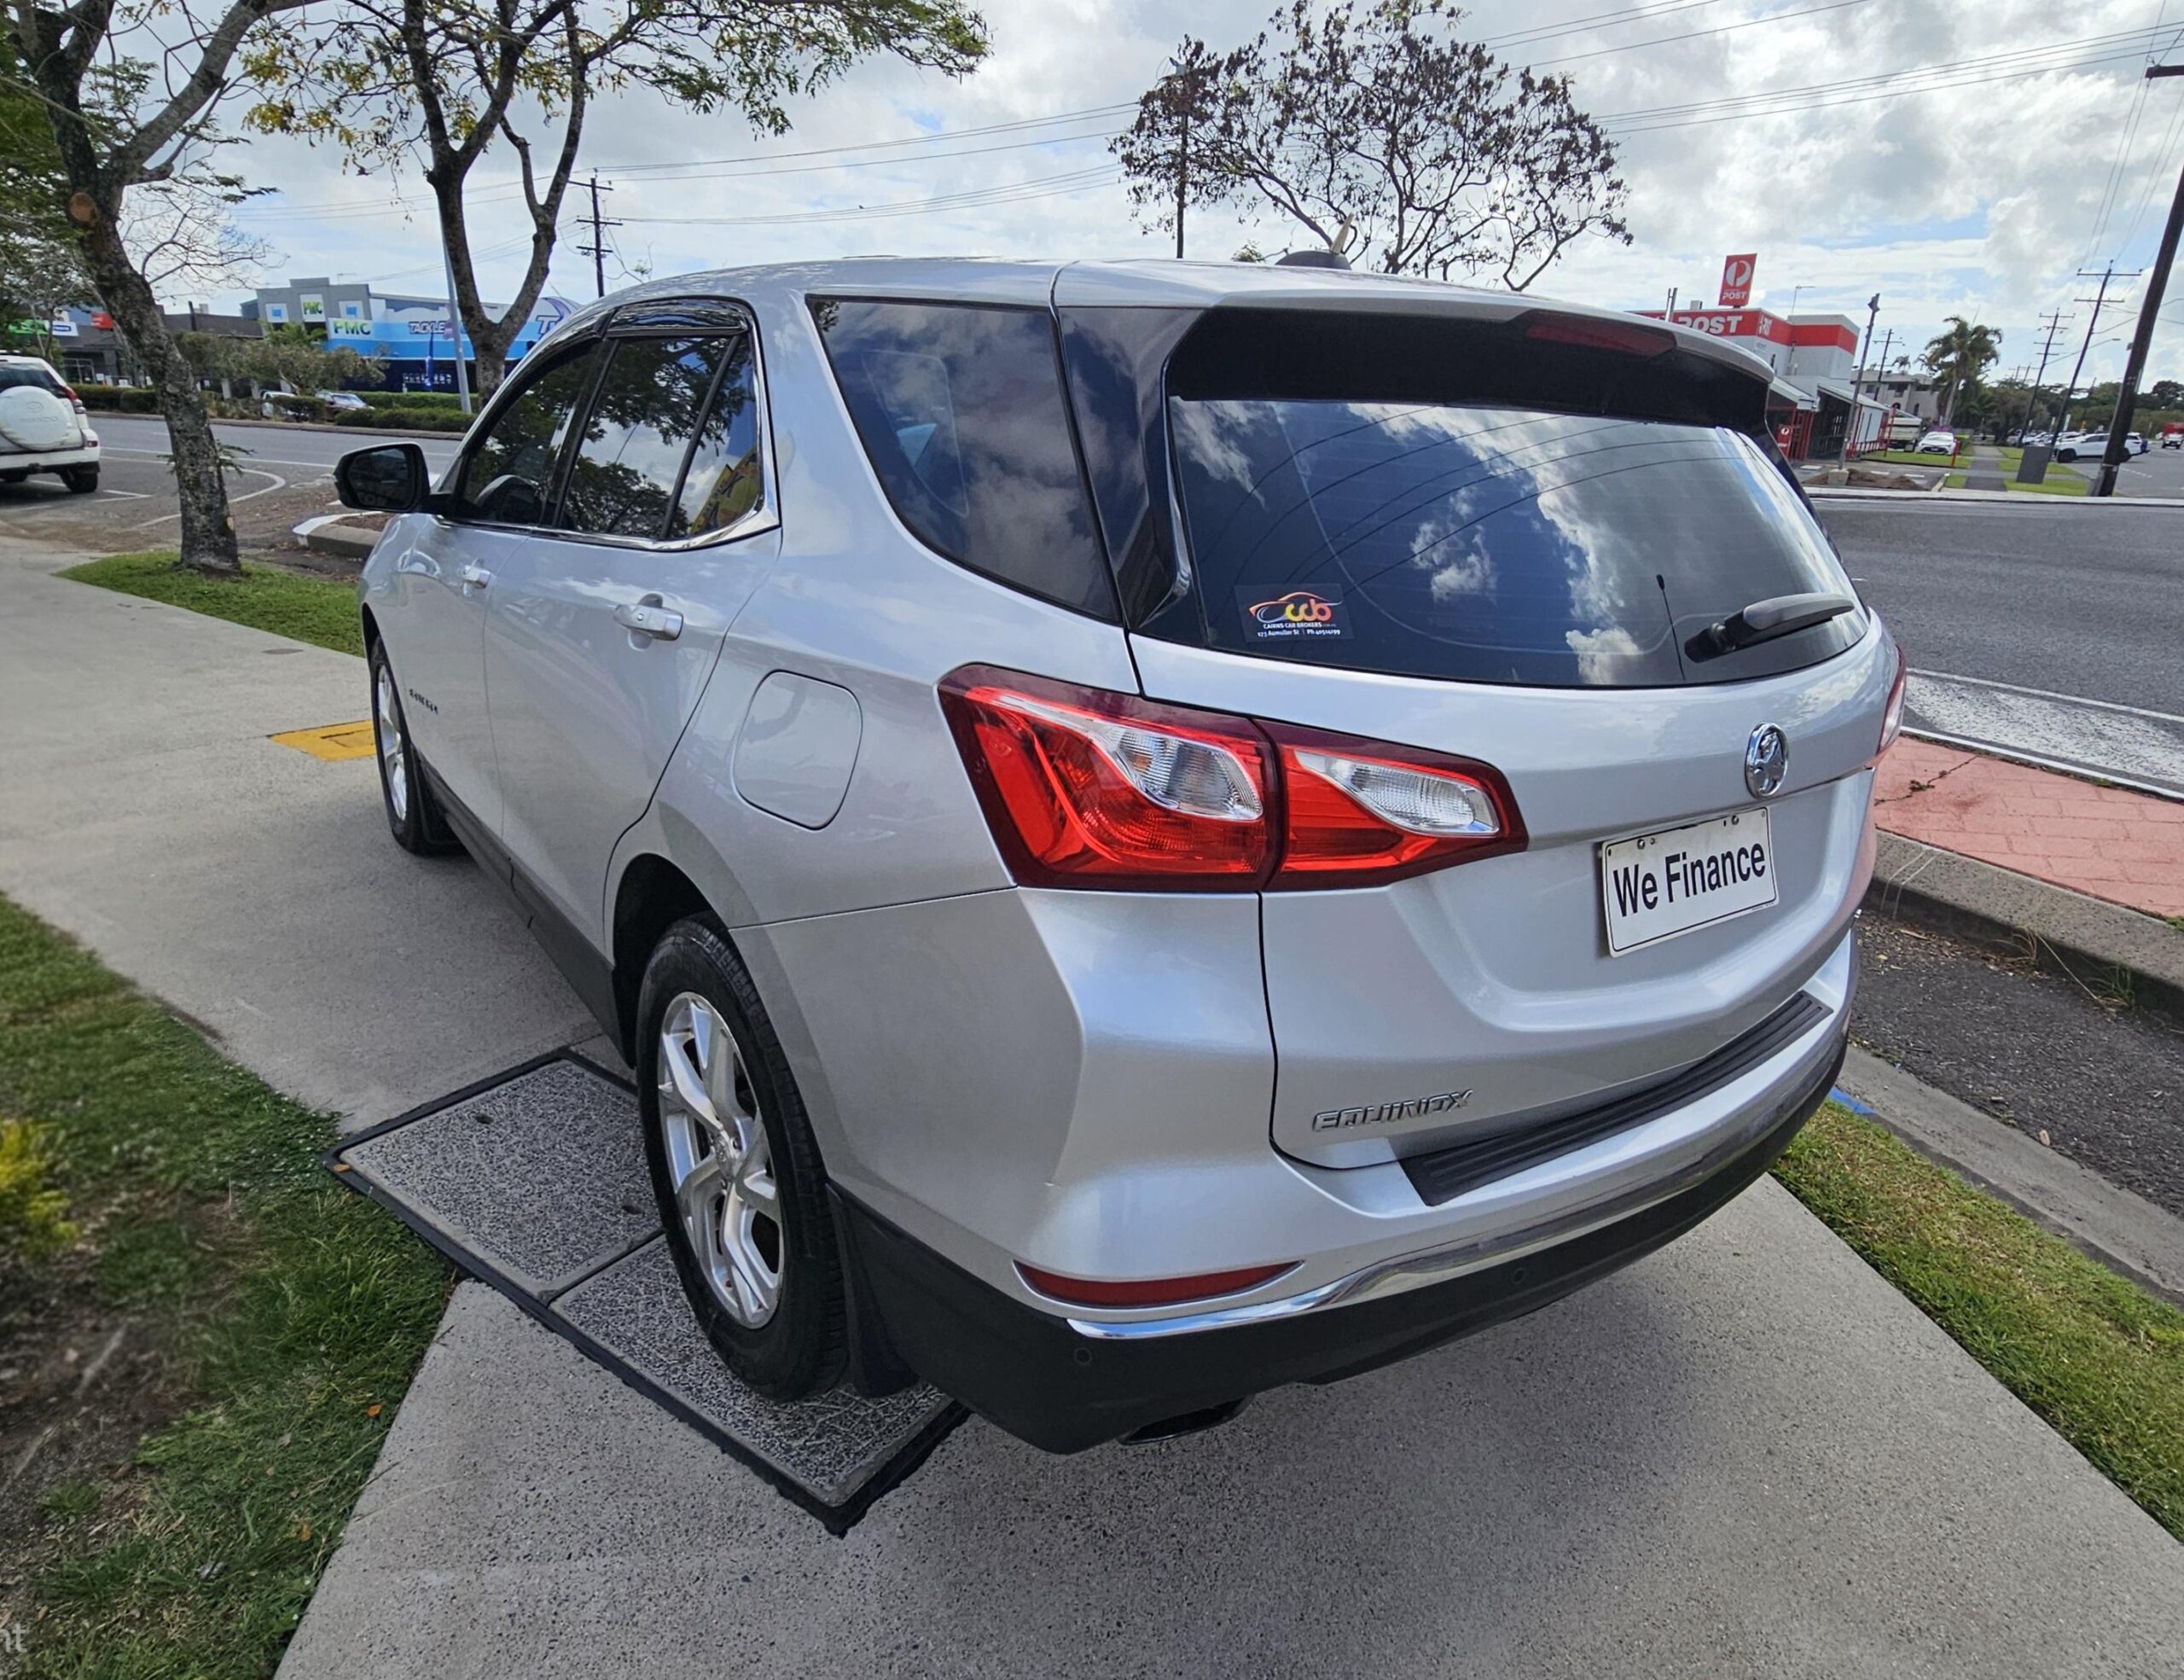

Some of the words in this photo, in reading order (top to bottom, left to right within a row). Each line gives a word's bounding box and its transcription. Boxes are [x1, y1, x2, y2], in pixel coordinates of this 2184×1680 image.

[303, 301, 322, 315] PMC
[333, 320, 371, 335] PMC
[409, 321, 447, 334] TACKLE
[1613, 864, 1658, 917] We
[1665, 843, 1766, 903] Finance
[1312, 1088, 1473, 1132] EQUINOX
